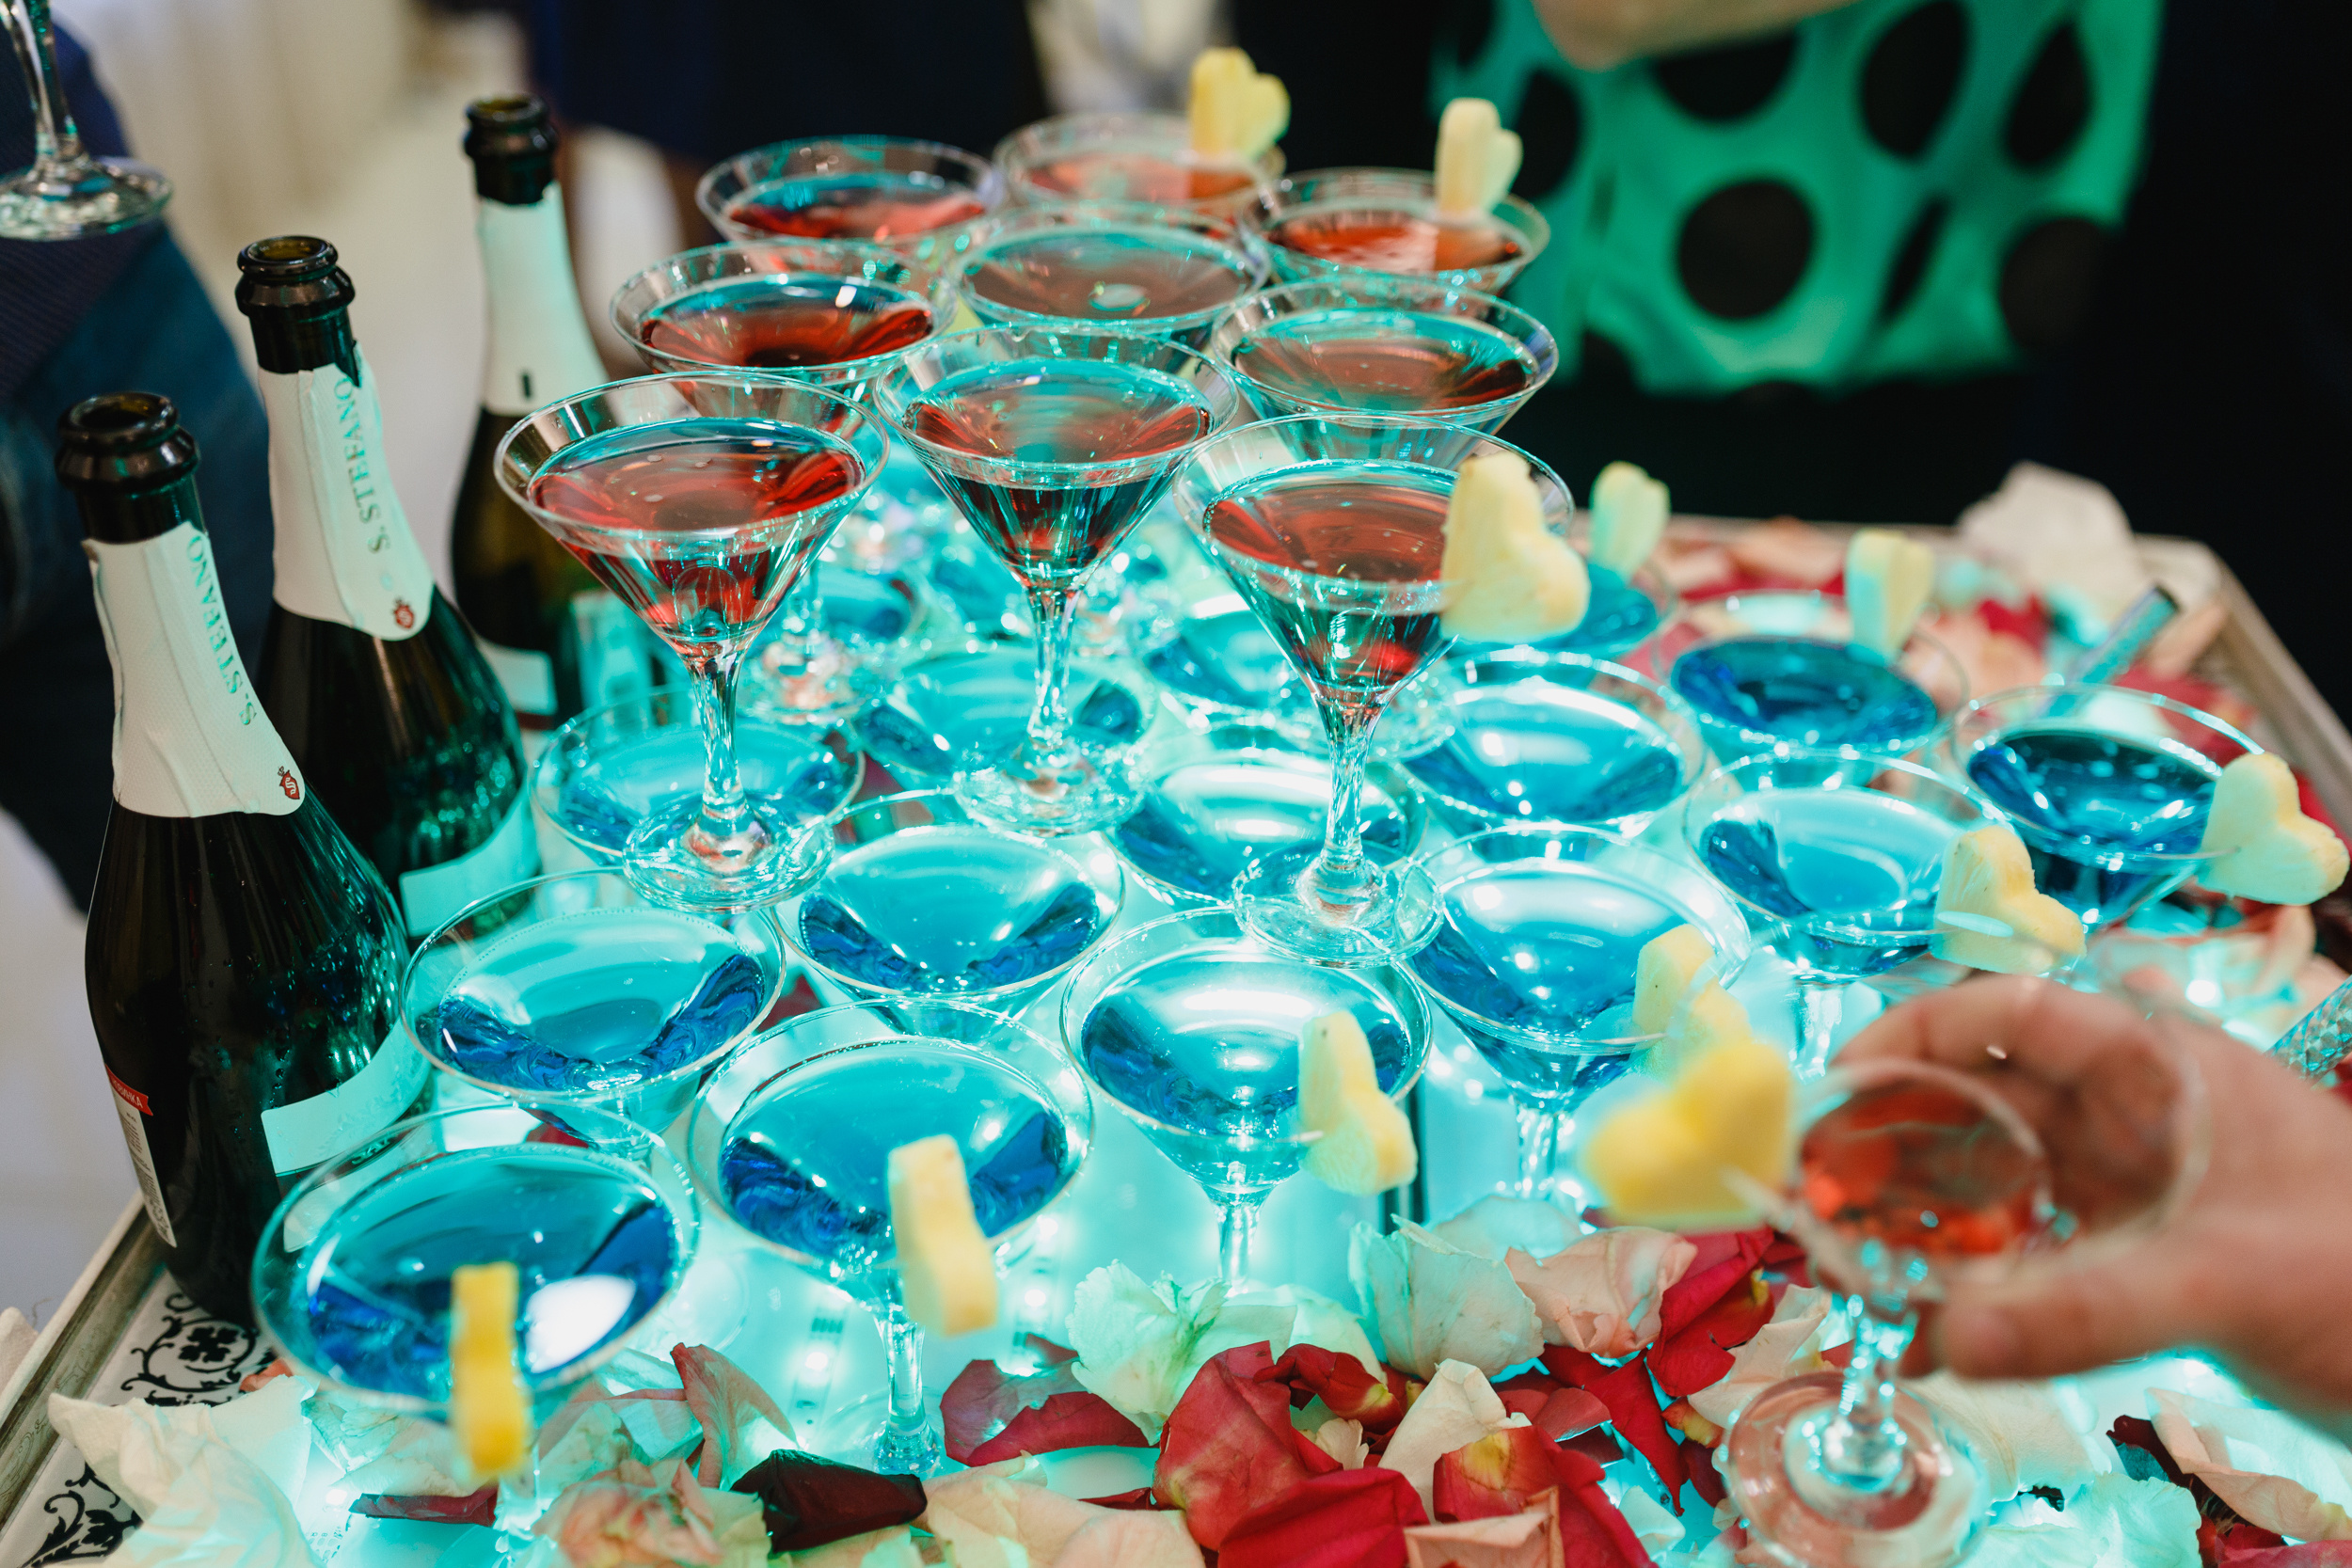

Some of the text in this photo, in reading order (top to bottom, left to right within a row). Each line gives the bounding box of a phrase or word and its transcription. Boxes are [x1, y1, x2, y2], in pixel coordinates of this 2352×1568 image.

[334, 375, 390, 555] S. STEFANO
[186, 535, 258, 725] S. STEFANO
